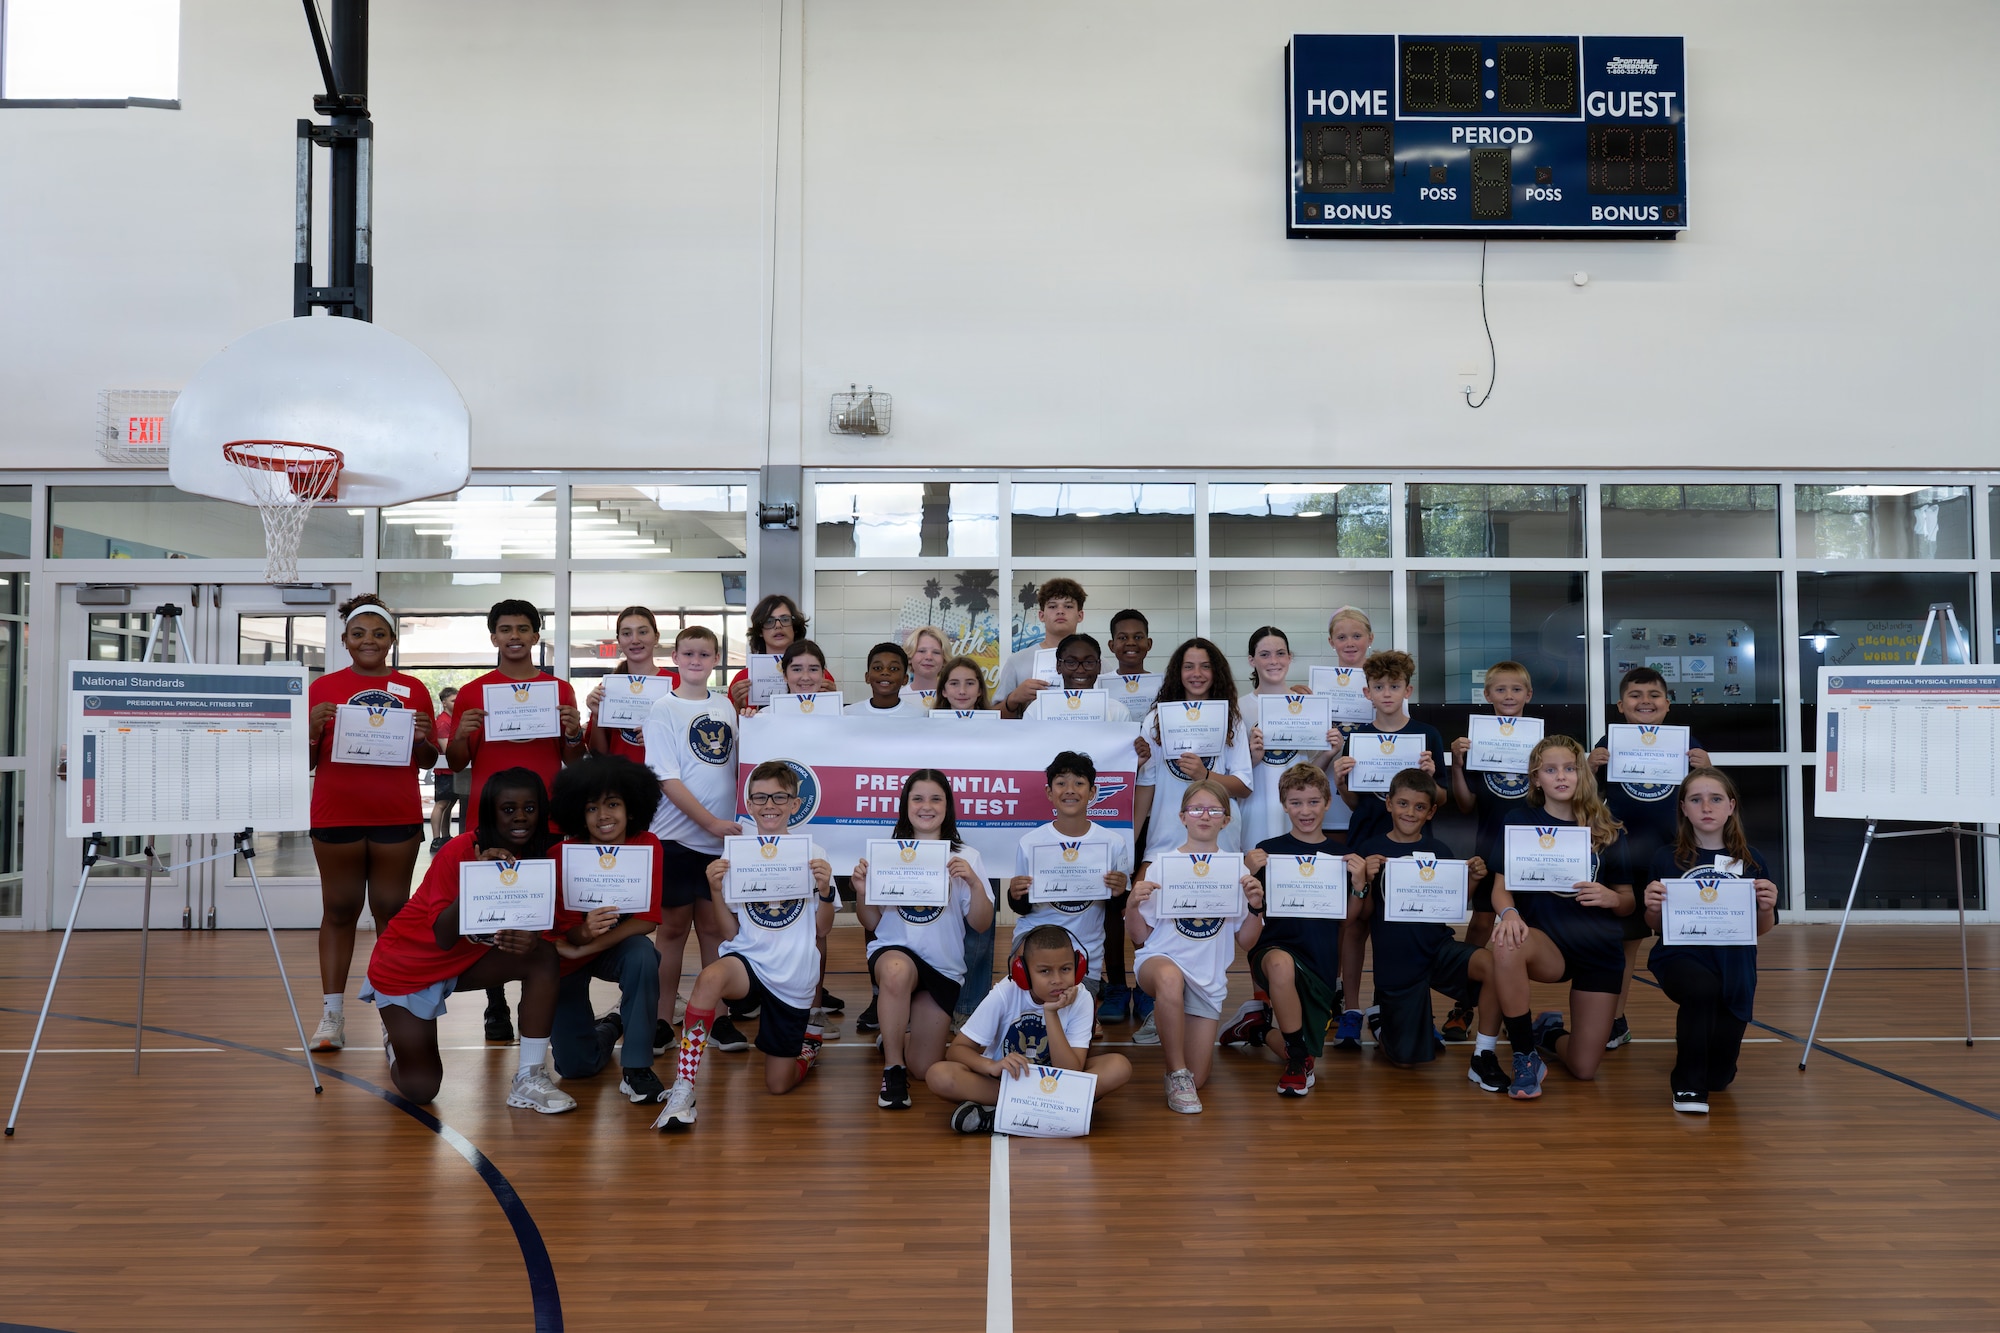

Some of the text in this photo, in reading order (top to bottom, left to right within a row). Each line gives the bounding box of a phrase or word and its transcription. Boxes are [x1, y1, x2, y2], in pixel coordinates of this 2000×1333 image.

[1307, 90, 1388, 116] HOME
[1587, 91, 1676, 118] GUEST
[1452, 127, 1533, 144] PERIOD
[1420, 188, 1457, 201] POSS
[1525, 188, 1562, 202] POSS
[1324, 205, 1392, 220] BONUS
[1591, 206, 1659, 221] BONUS
[129, 417, 164, 444] EXIT
[1867, 622, 1912, 632] Outstanding
[1864, 652, 1900, 661] WORDS
[82, 676, 185, 688] National Standards
[790, 763, 808, 779] COUNCIL
[796, 795, 814, 821] NUTRITION
[960, 799, 1018, 815] TEST
[1011, 1097, 1039, 1107] PHYSICAL
[1040, 1102, 1064, 1111] FITNESS
